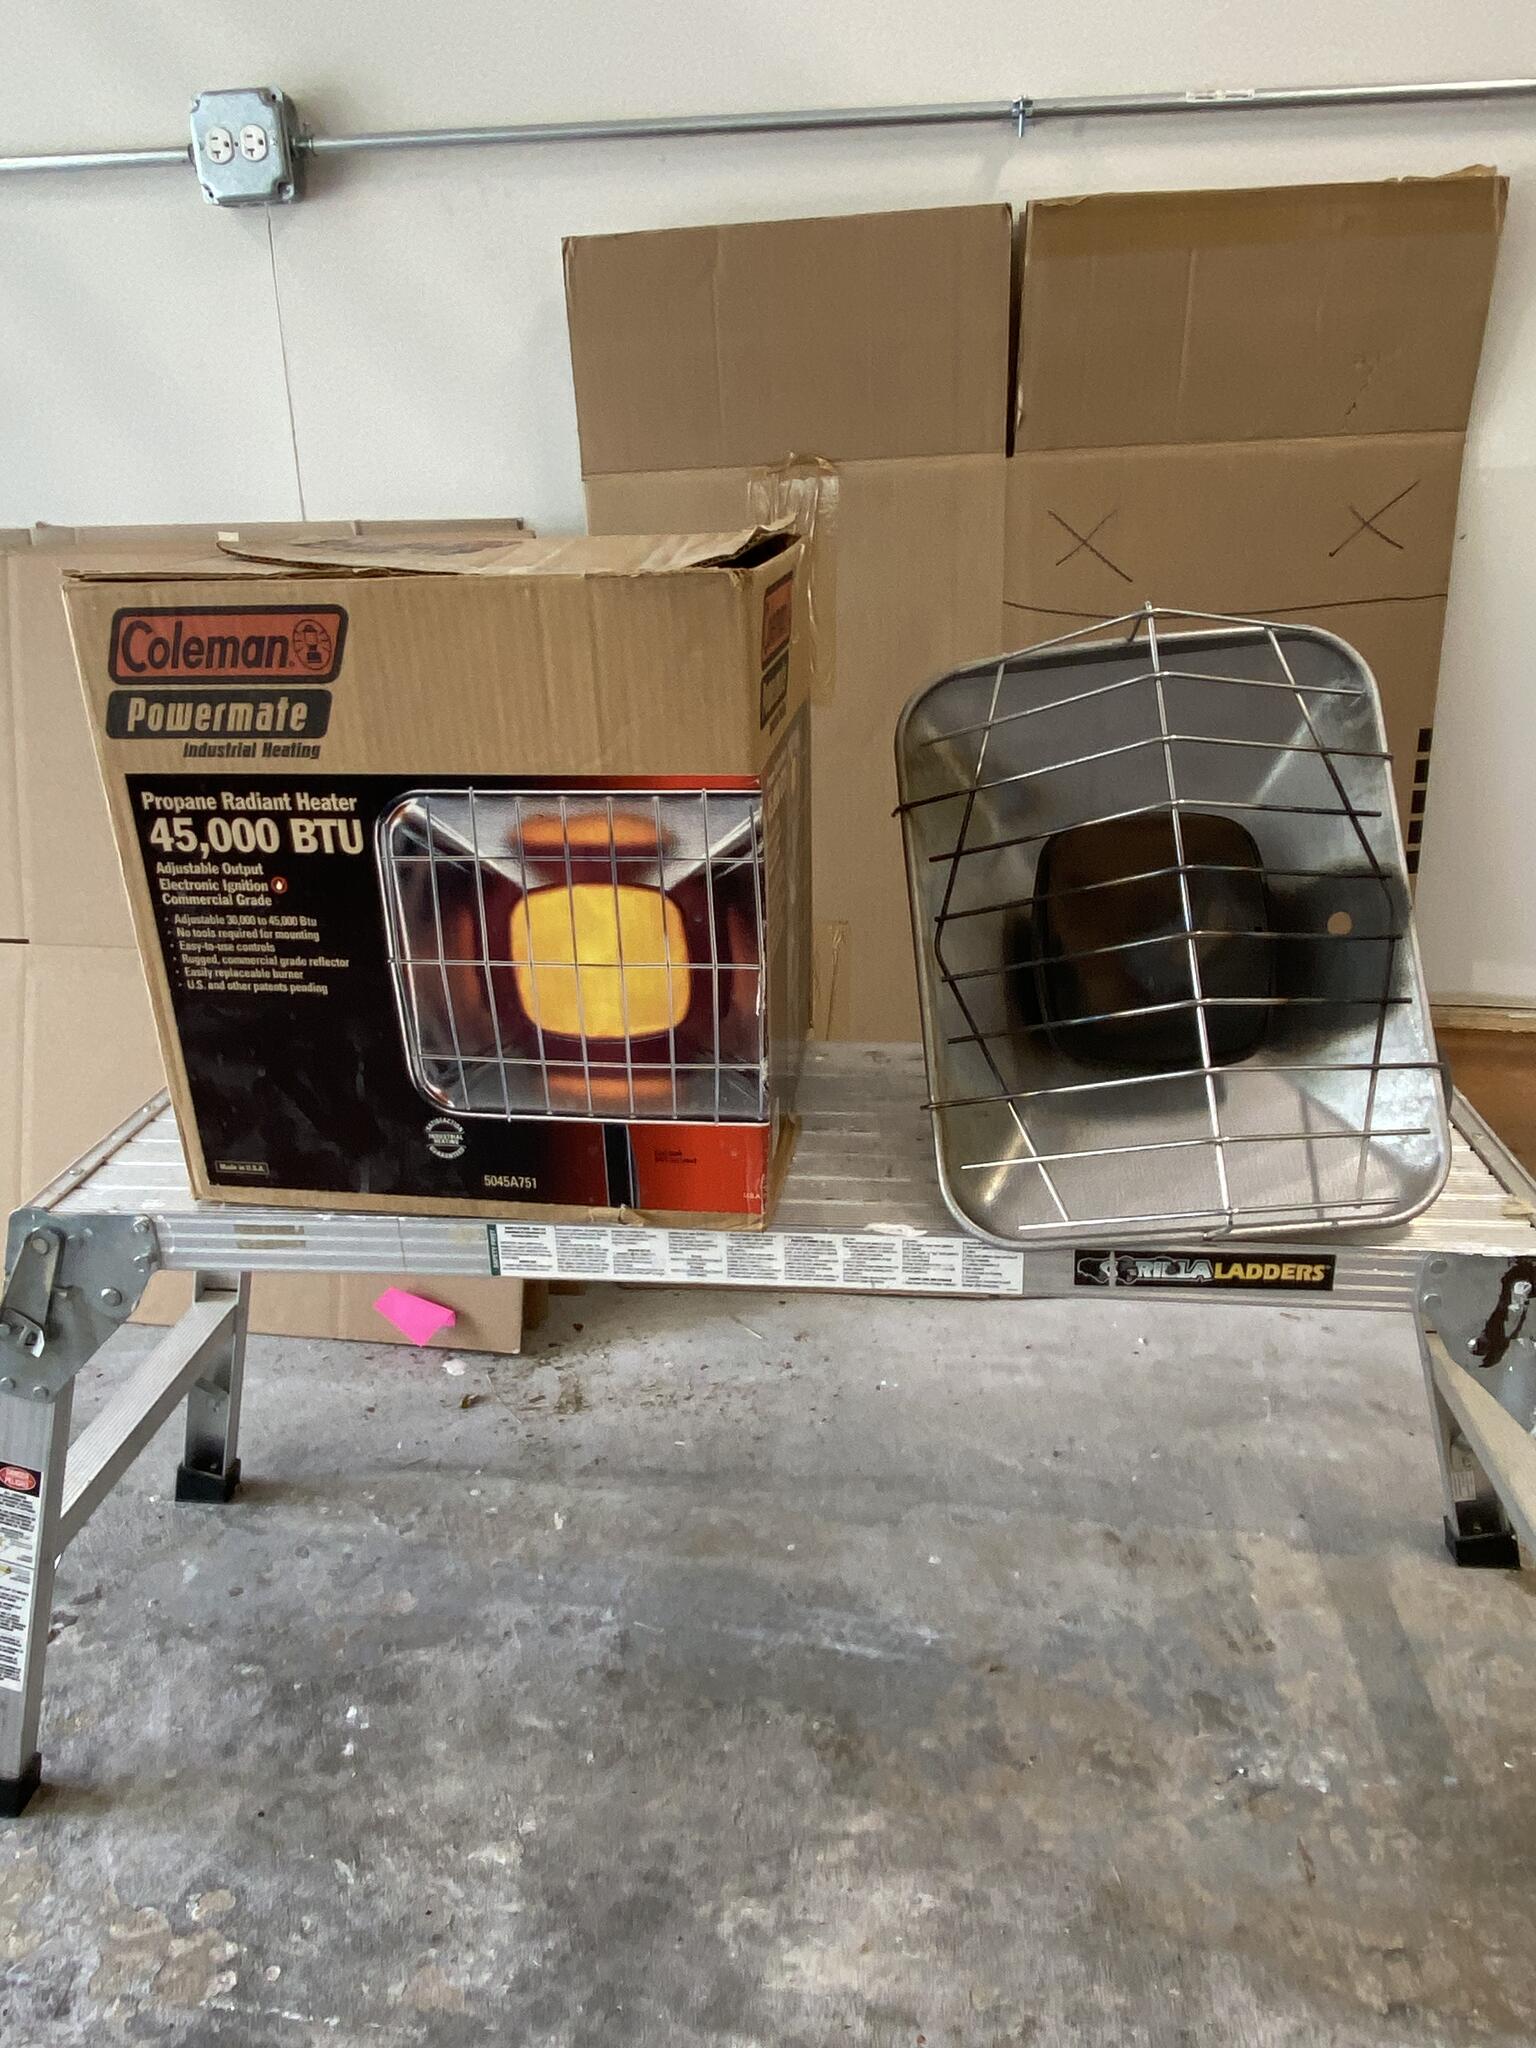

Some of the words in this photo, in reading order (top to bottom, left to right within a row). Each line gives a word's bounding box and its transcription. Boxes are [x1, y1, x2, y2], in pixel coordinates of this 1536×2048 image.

[122, 620, 290, 672] Coleman
[127, 697, 308, 732] Powermate
[183, 742, 257, 758] Industrial
[262, 742, 321, 759] Heating
[141, 792, 217, 813] Propane
[220, 792, 292, 811] Radiant
[295, 793, 357, 812] Heater
[150, 817, 280, 859] 45,000
[289, 818, 364, 855] BTU
[156, 862, 219, 876] Adjustable
[222, 863, 264, 877] Output
[160, 878, 219, 892] Electronic
[223, 879, 268, 893] Ignition
[162, 894, 234, 906] Commercial
[236, 894, 272, 906] Grade
[174, 914, 225, 926] Adjustable
[257, 916, 267, 926] to
[268, 915, 298, 927] 45,000
[299, 916, 317, 927] Btu
[176, 927, 191, 938] No
[192, 928, 216, 938] tools
[218, 928, 258, 941] required
[259, 929, 273, 939] for
[274, 930, 320, 942] mounting
[179, 941, 234, 953] Easy-to-use
[236, 942, 276, 953] controls
[222, 955, 278, 966] commercial
[279, 956, 307, 968] grade
[308, 956, 350, 968] reflector
[184, 967, 213, 979] Easily
[215, 967, 271, 979] replaceable
[272, 968, 304, 979] burner
[208, 981, 225, 991] and
[227, 981, 252, 991] other
[253, 983, 288, 994] patents
[289, 983, 328, 995] pending
[484, 1175, 537, 1189] 5045A751
[1214, 1262, 1327, 1282] LADDERS
